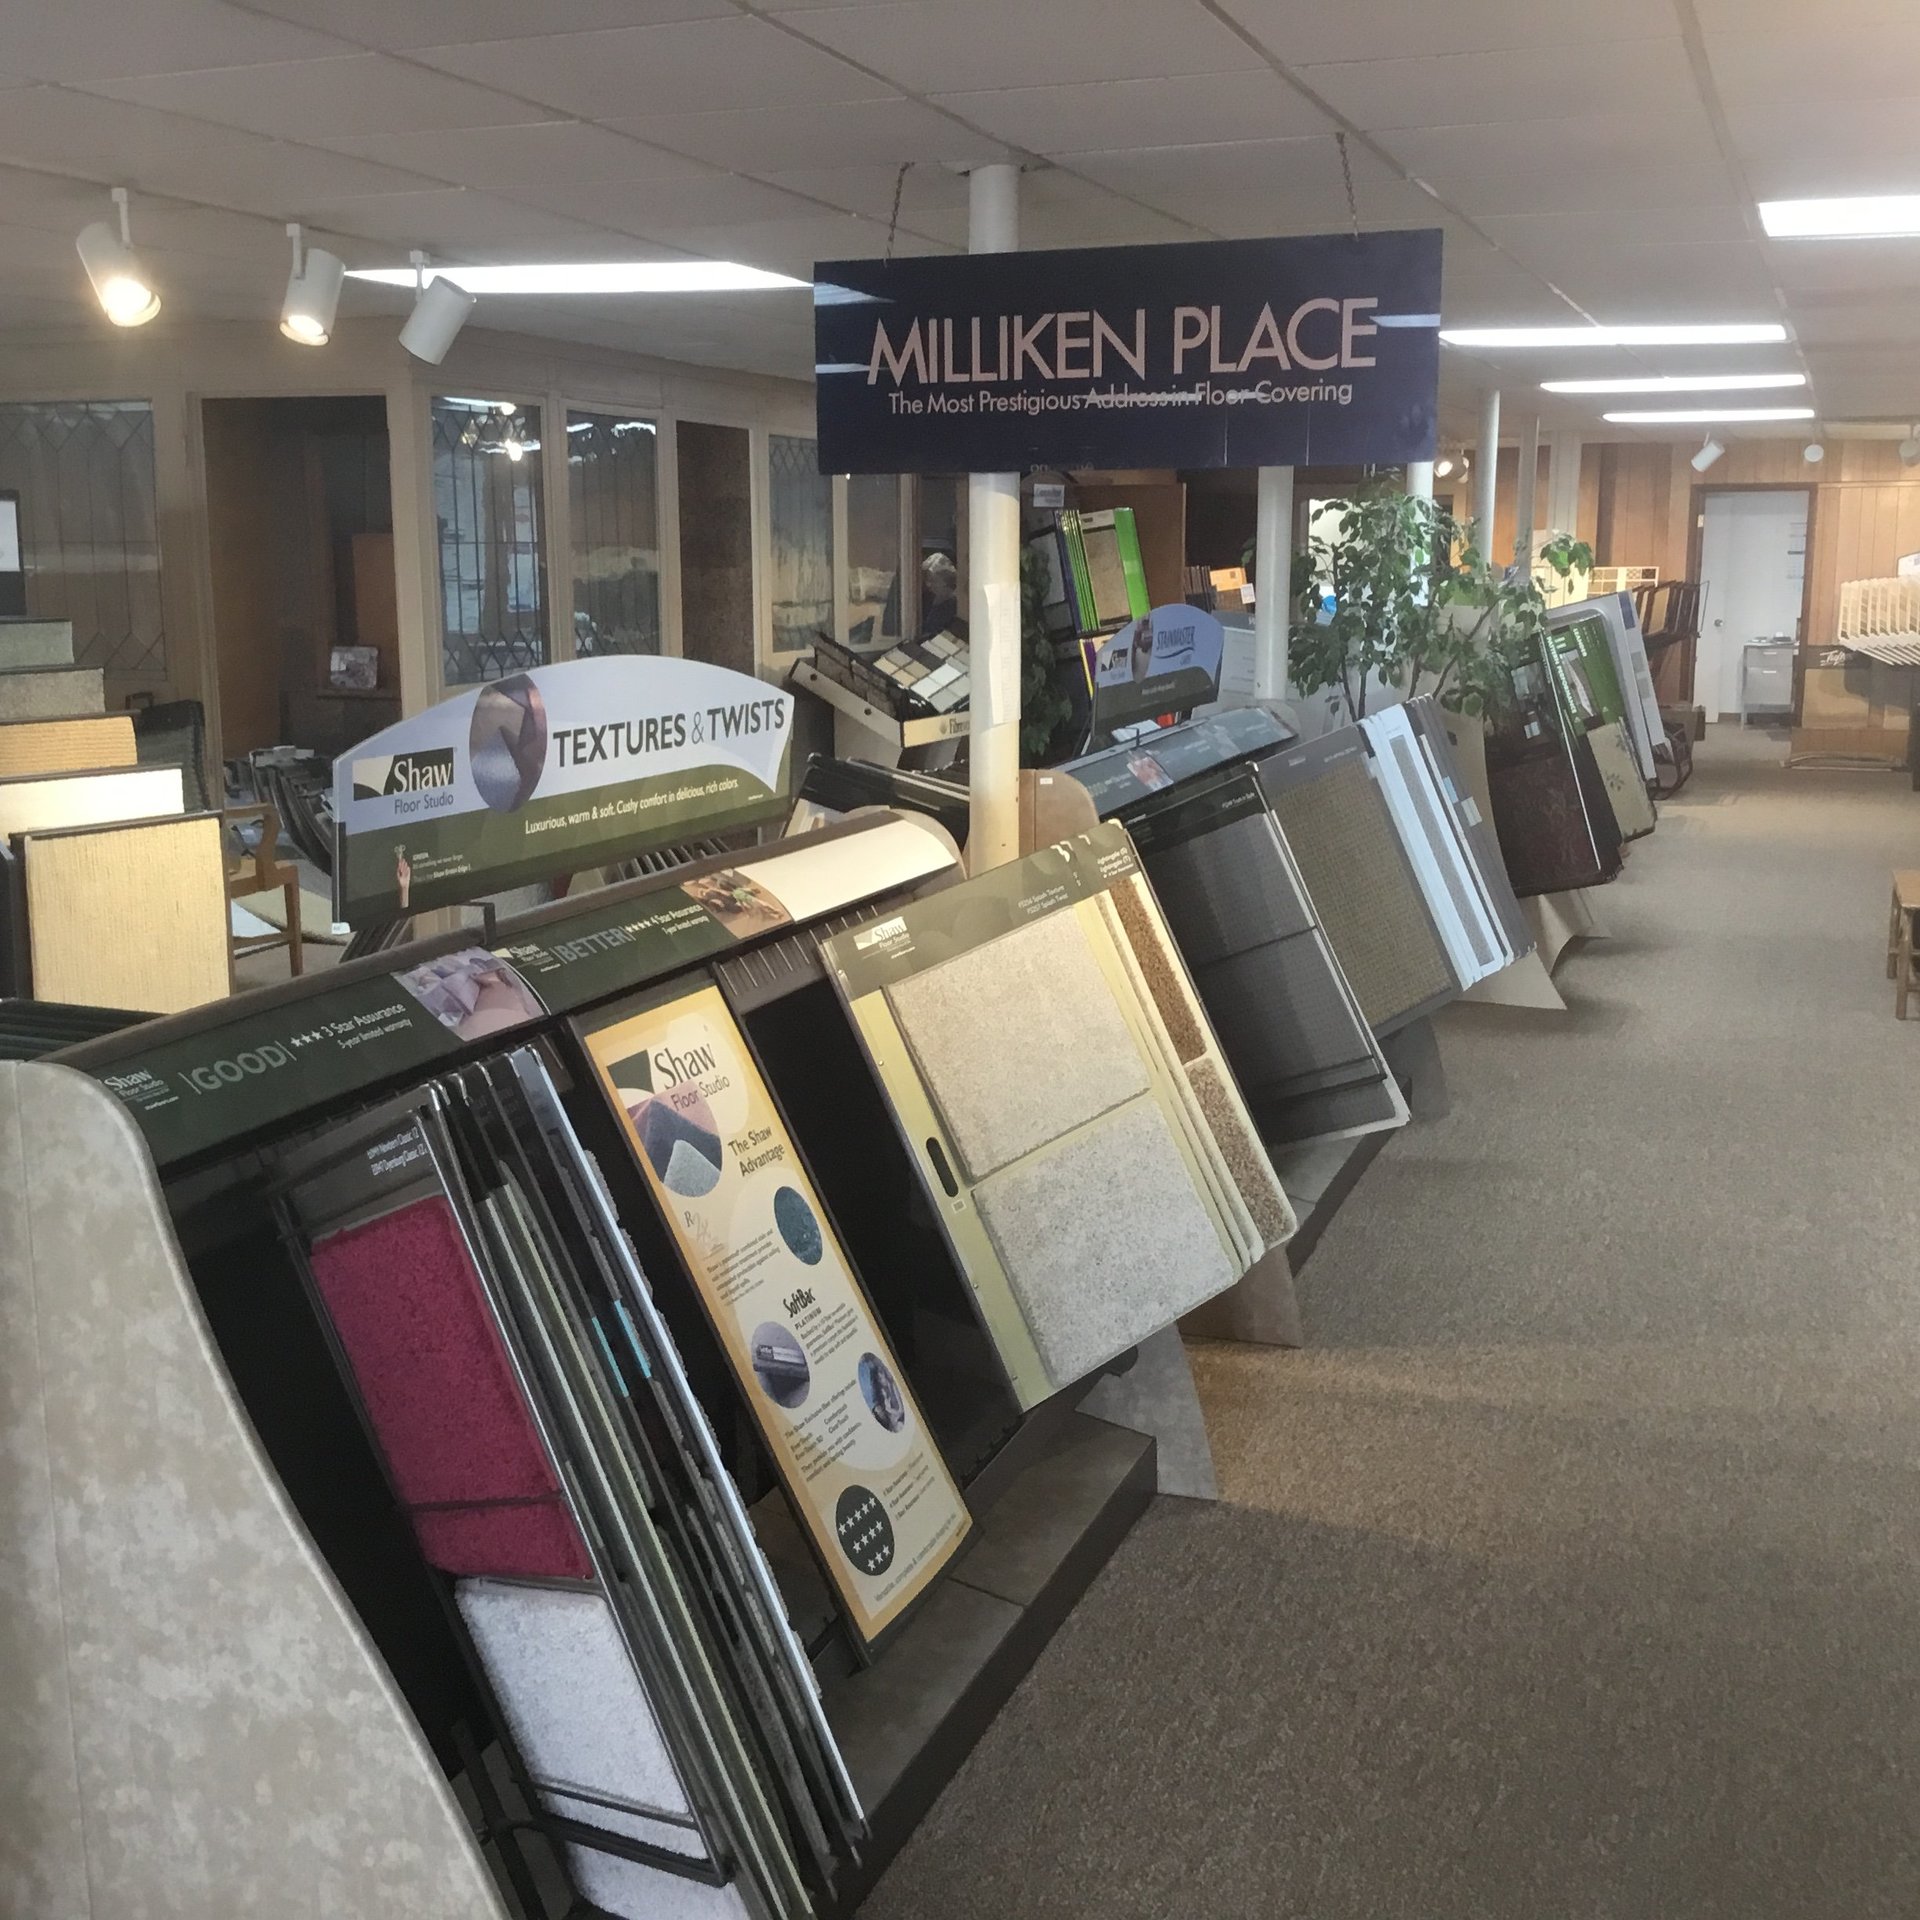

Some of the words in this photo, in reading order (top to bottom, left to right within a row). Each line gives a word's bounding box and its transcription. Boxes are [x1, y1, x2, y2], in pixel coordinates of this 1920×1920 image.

[867, 308, 1146, 386] MILLIKEN
[1174, 297, 1379, 375] PLACE
[889, 391, 923, 414] The
[927, 392, 974, 413] Most
[979, 388, 1081, 416] Prestigious
[1084, 384, 1166, 409] Address
[1172, 384, 1190, 407] in
[1195, 380, 1246, 405] Floor
[1255, 378, 1353, 405] Covering
[553, 713, 686, 768] TEXTURES
[692, 711, 704, 745] &
[707, 698, 784, 741] TWISTS
[394, 757, 452, 795] Shaw
[395, 799, 420, 815] Floor
[424, 792, 454, 809] Studio
[525, 816, 568, 835] Luxurious,
[568, 811, 590, 825] warm
[592, 806, 598, 820] &
[600, 804, 616, 819] soft.
[617, 800, 638, 814] Cushy
[640, 794, 667, 809] comfort
[668, 791, 675, 802] in
[676, 785, 705, 802] delicious,
[706, 781, 717, 793] rich
[555, 927, 631, 962] BETTER
[874, 925, 903, 941] Shaw
[320, 1025, 334, 1037] 3
[330, 1020, 356, 1034] Star
[353, 1004, 406, 1027] Assurance
[104, 1069, 153, 1092] Shaw
[191, 1045, 288, 1090] GOOD
[654, 1043, 716, 1090] Shaw
[670, 1089, 700, 1112] Floor
[699, 1074, 730, 1098] Studio
[728, 1138, 749, 1156] The
[752, 1126, 773, 1146] Shaw
[739, 1143, 785, 1177] Advantage
[794, 1307, 822, 1330] PLATINUM
